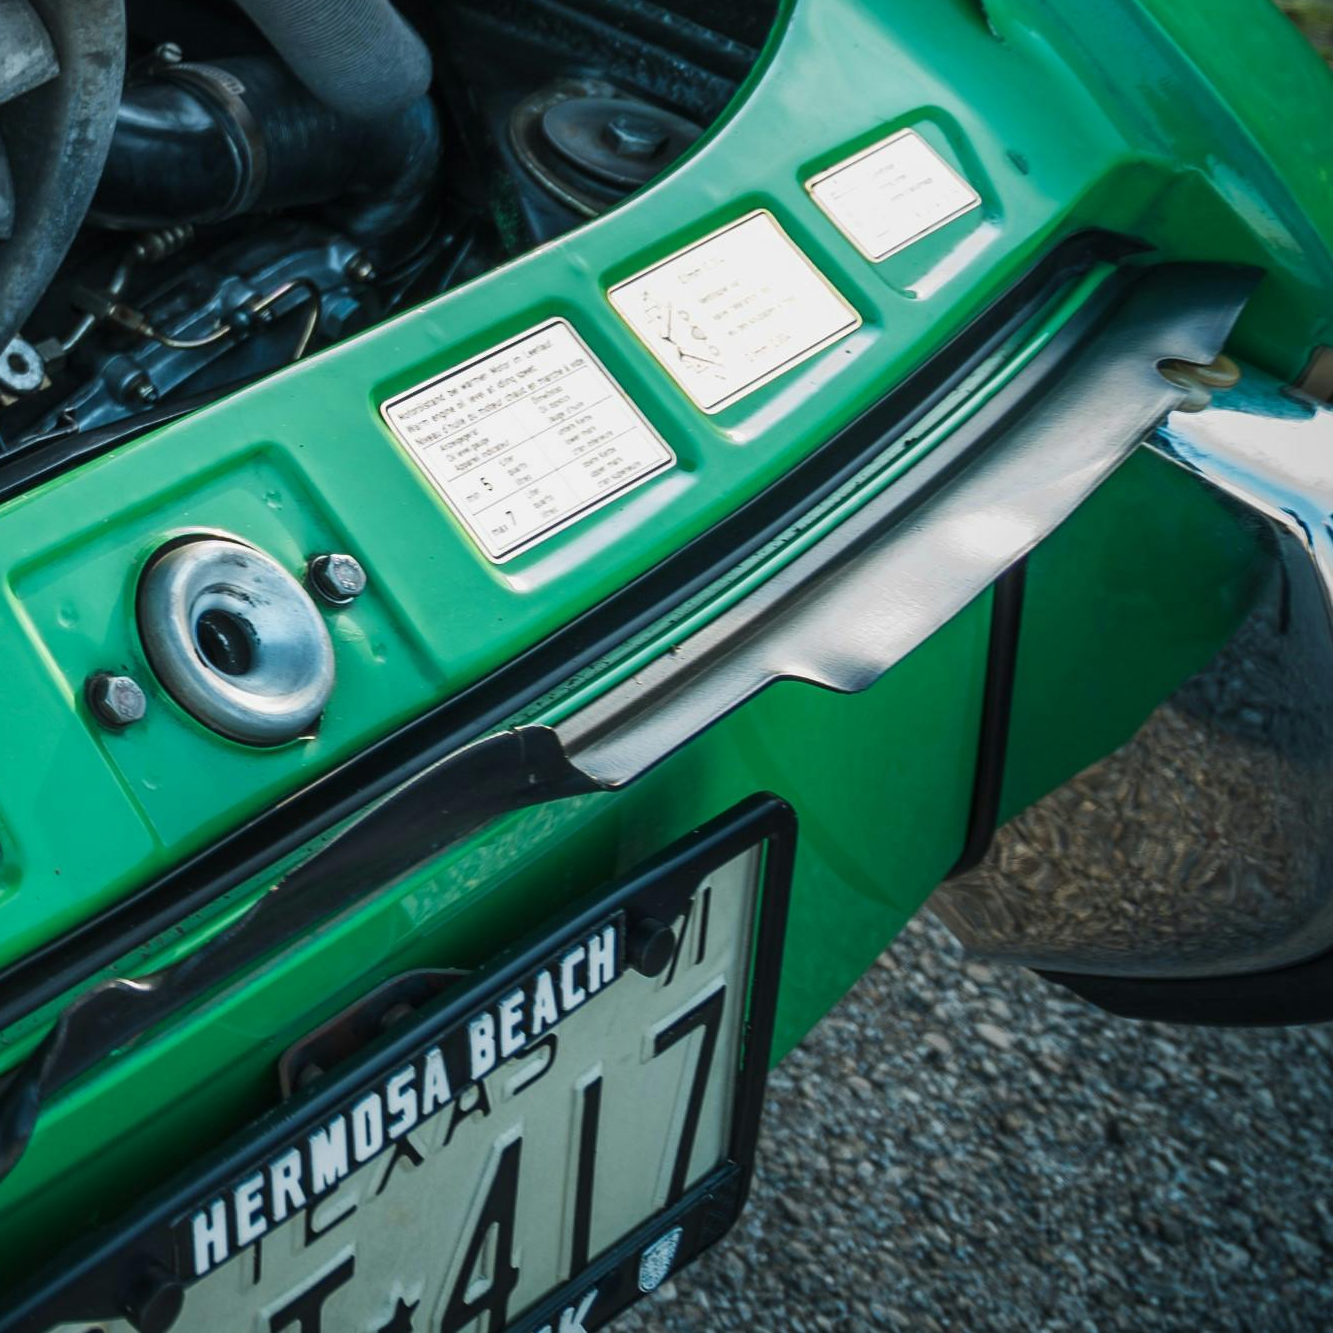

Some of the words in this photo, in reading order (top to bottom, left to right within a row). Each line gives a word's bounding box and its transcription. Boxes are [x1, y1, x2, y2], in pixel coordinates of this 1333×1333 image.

[479, 476, 493, 491] 5
[503, 508, 517, 527] 7
[190, 1045, 453, 1277] HERMOSA
[469, 924, 618, 1082] BEACH
